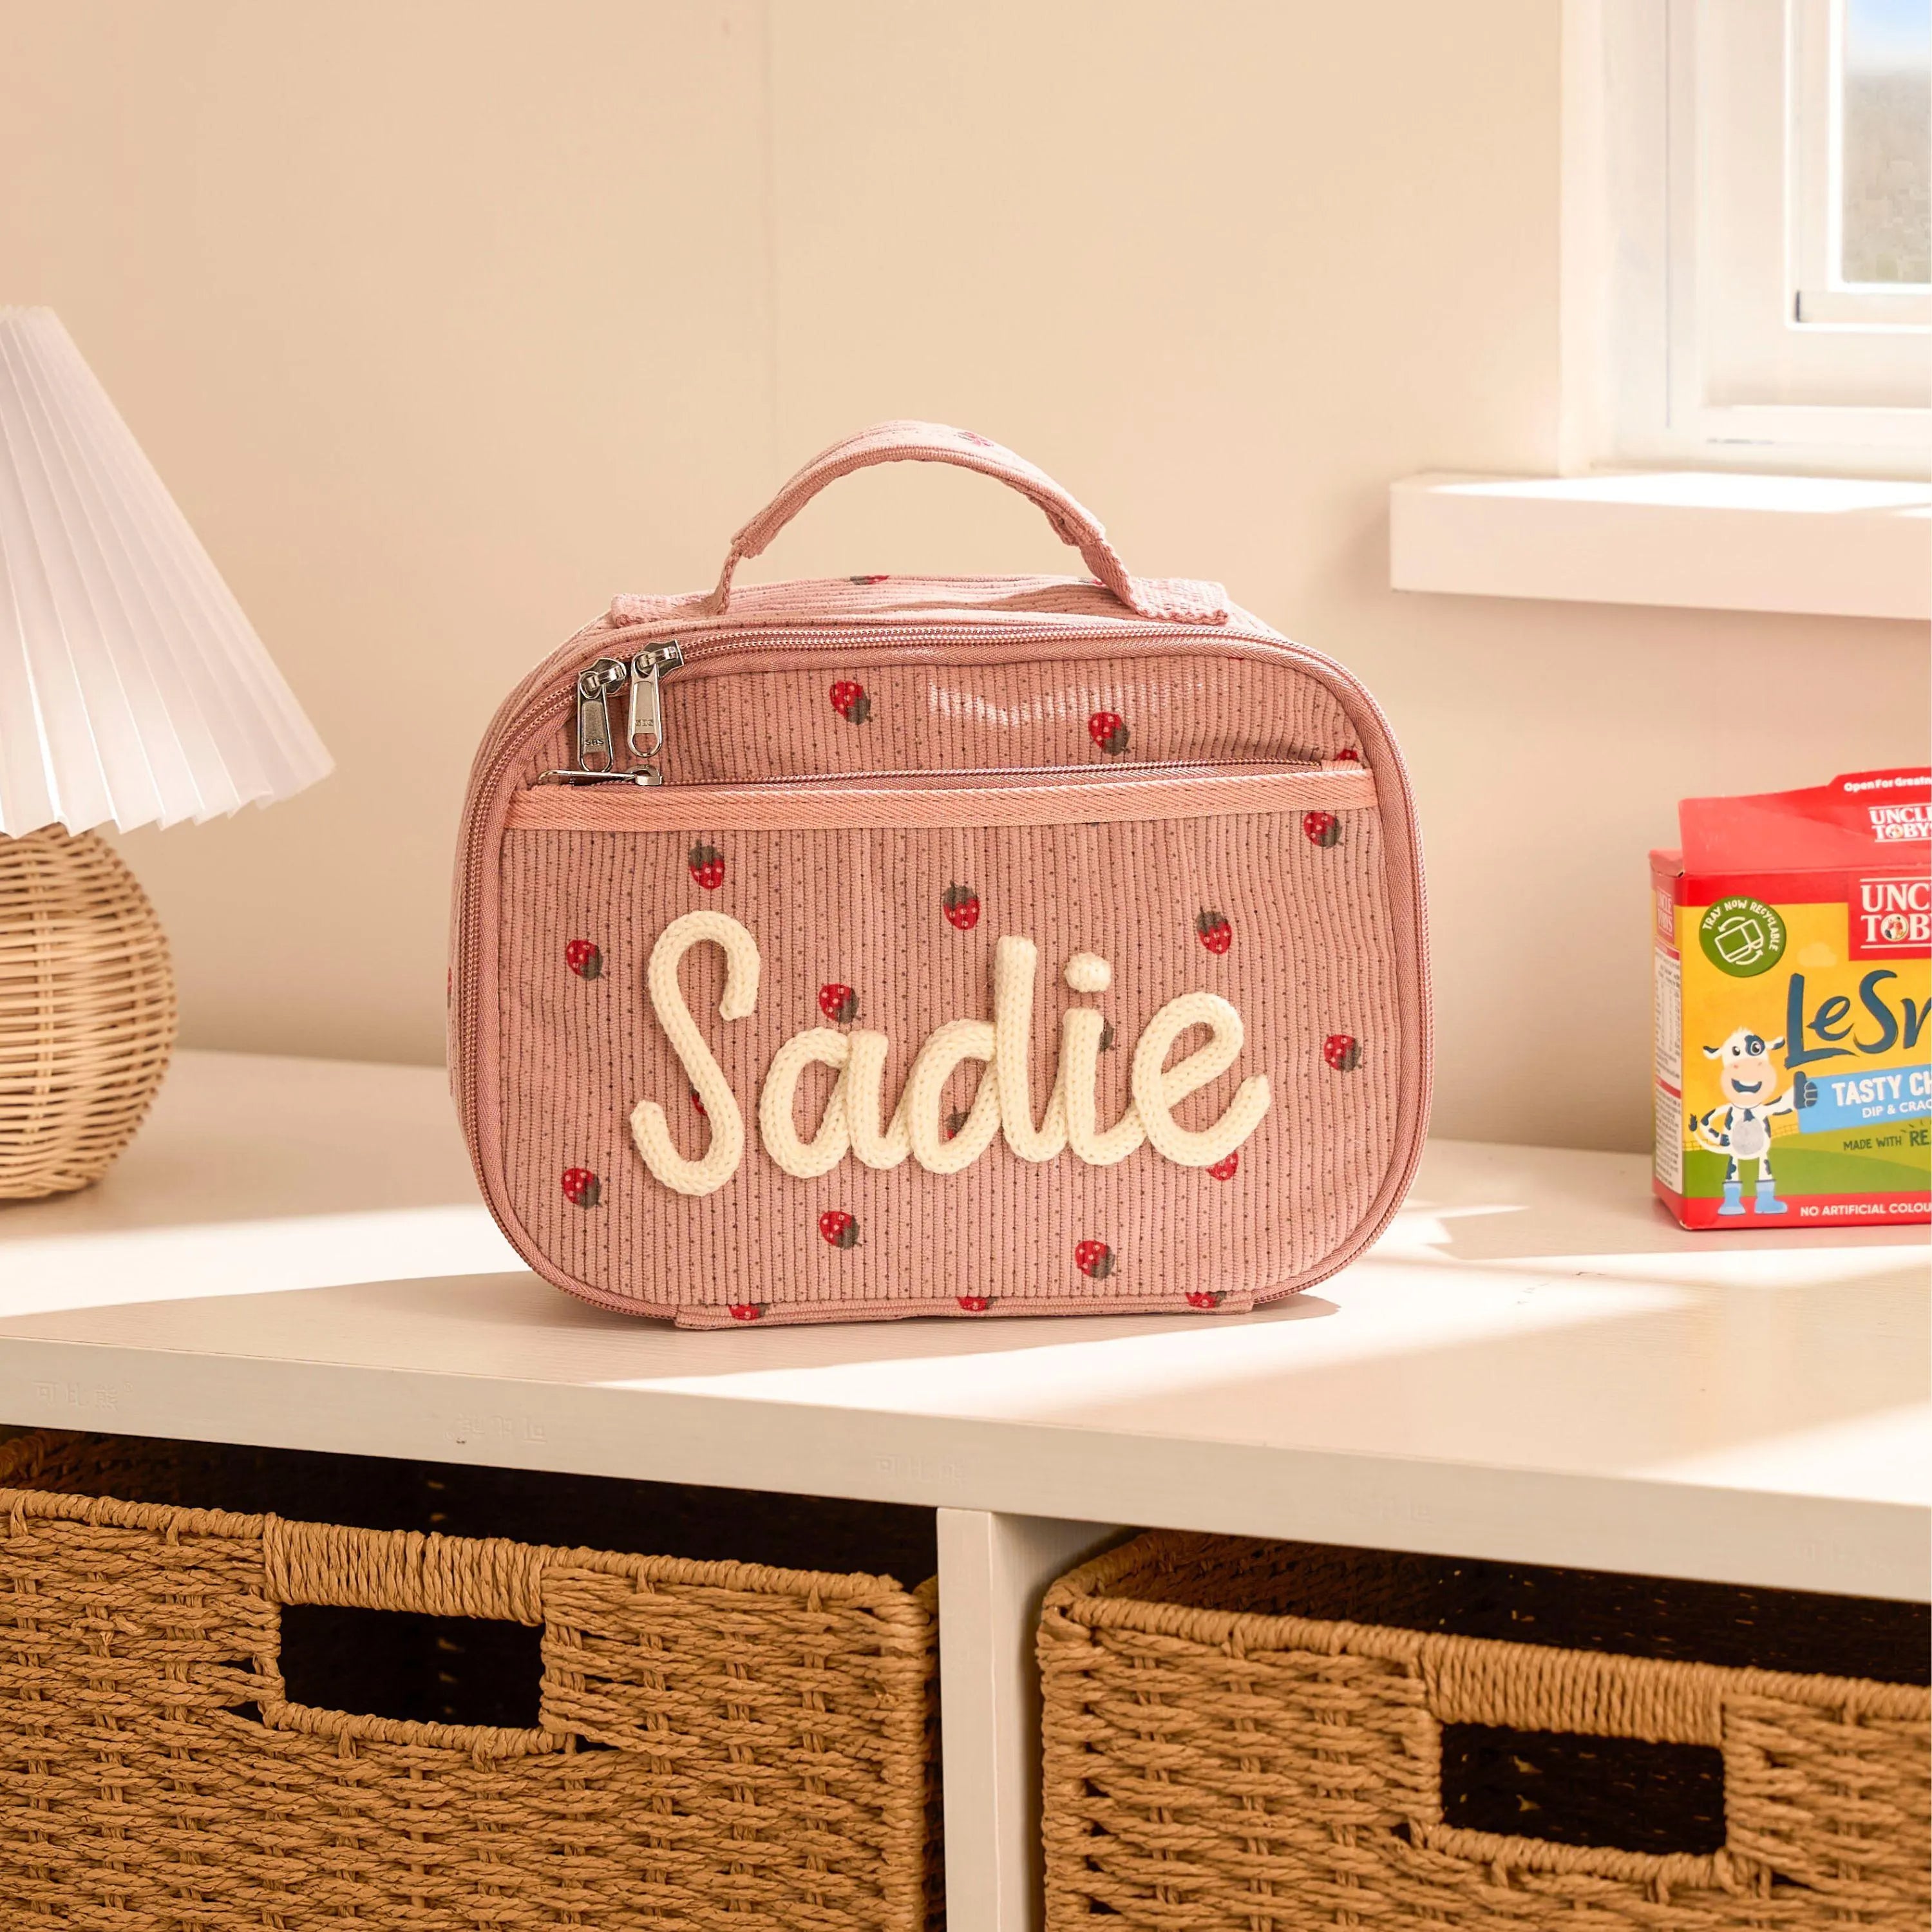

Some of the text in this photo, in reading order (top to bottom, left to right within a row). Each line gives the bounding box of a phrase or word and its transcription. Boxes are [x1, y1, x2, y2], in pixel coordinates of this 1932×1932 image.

[1844, 781, 1875, 793] Open
[1875, 779, 1893, 788] For
[1871, 823, 1931, 840] TOBY
[1860, 883, 1931, 913] UNC
[1702, 900, 1781, 951] TRAY NOW RECYCLABLE
[1860, 913, 1931, 942] TOB
[630, 909, 1271, 1197] Sadie
[1832, 1074, 1902, 1106] TASTY
[1862, 1106, 1884, 1118] DIP
[1887, 1104, 1895, 1115] &
[1843, 1129, 1931, 1151] MADE WITH RE
[1800, 1202, 1931, 1217] NO ARTIFICIAL COLOU
